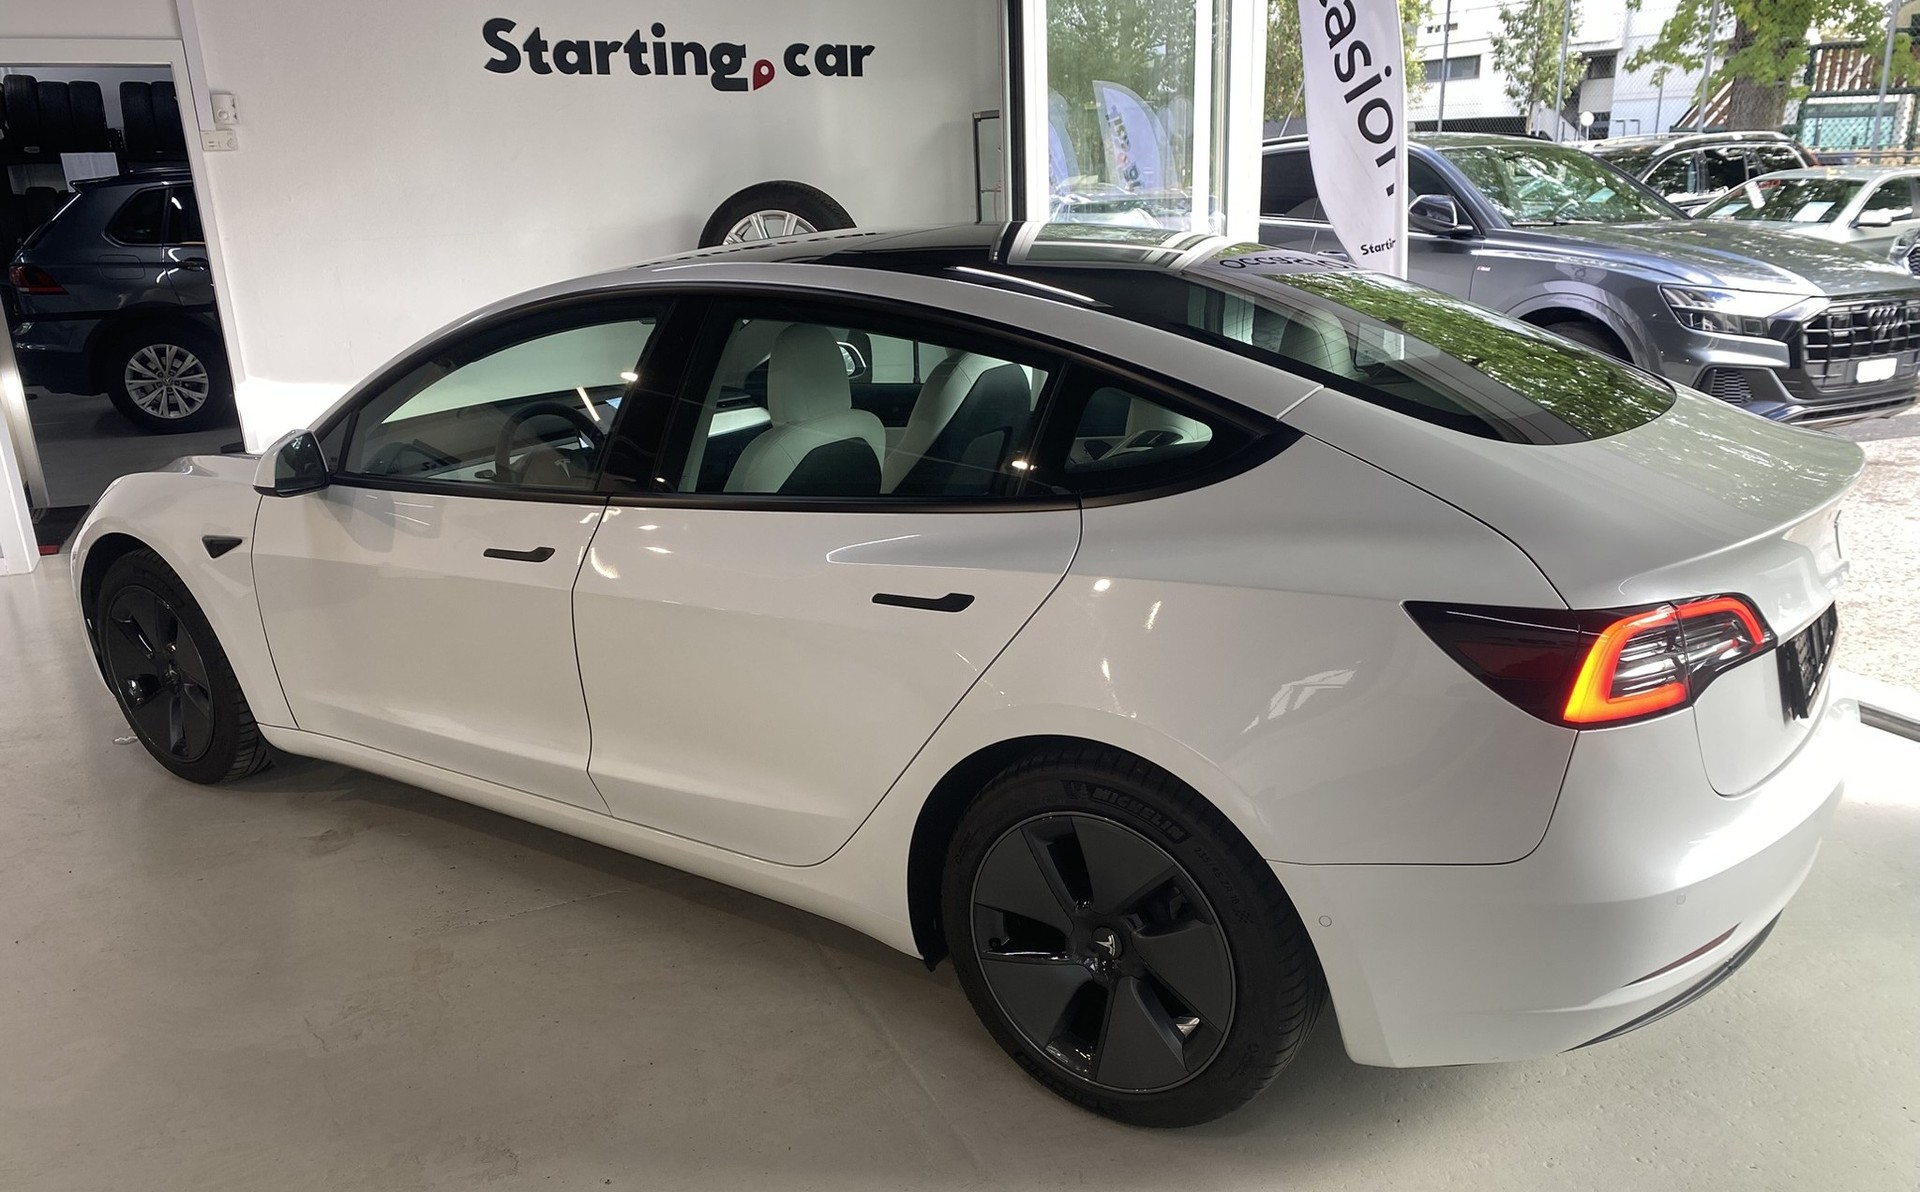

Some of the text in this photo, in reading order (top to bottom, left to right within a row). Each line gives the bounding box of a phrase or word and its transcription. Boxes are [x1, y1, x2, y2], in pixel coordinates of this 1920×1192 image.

[482, 17, 876, 92] Starting car
[1091, 786, 1186, 841] MICHELIN
